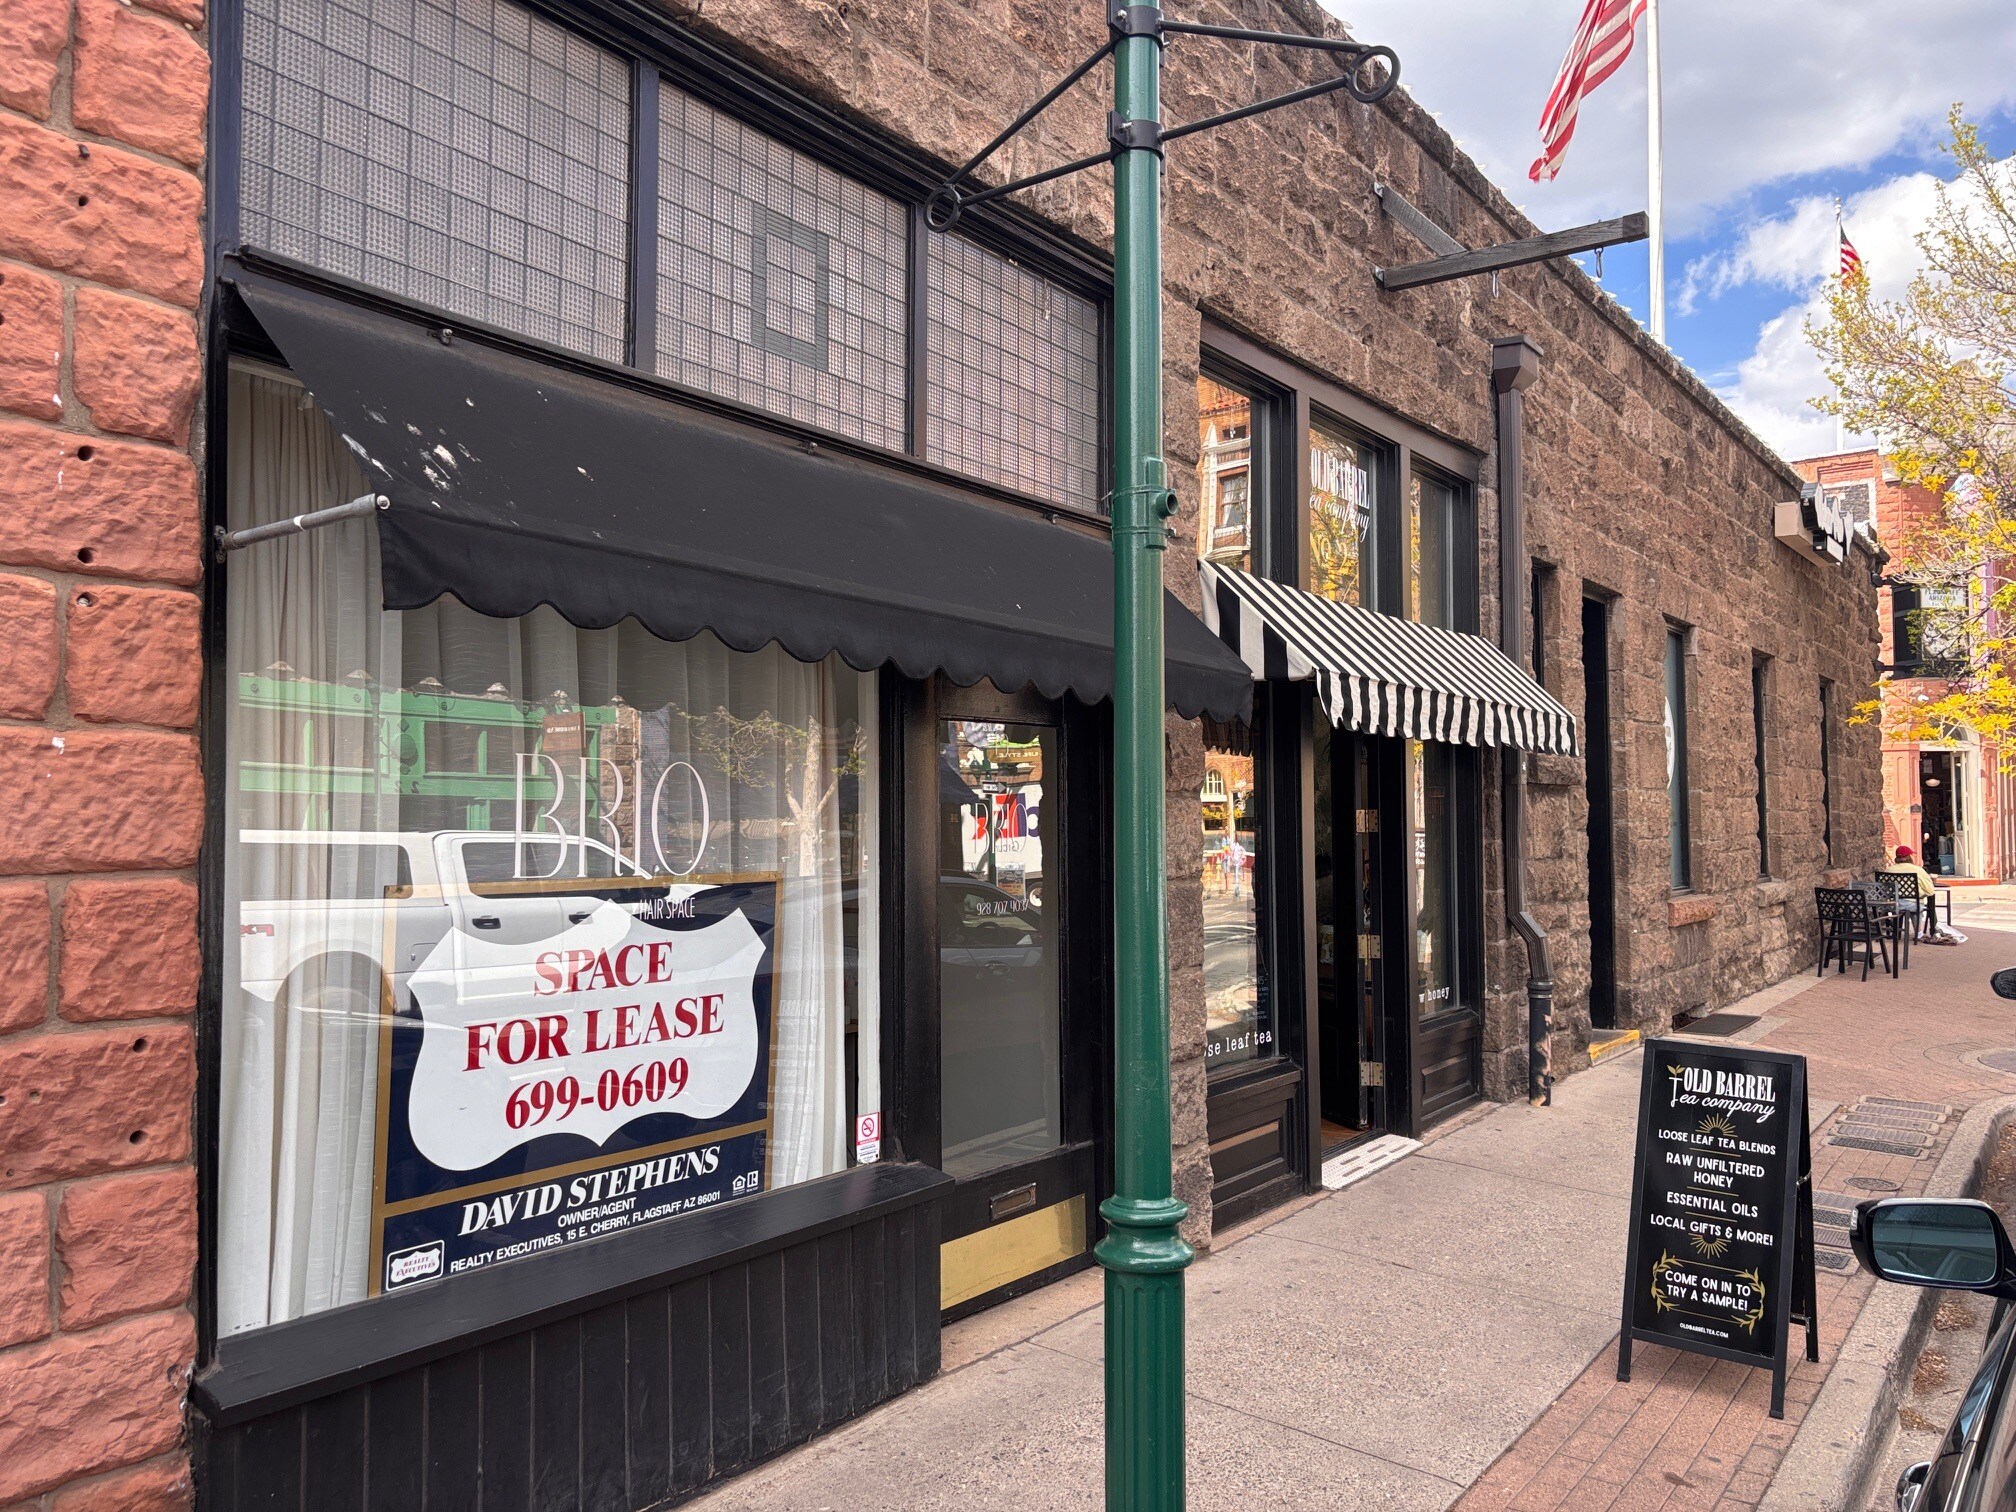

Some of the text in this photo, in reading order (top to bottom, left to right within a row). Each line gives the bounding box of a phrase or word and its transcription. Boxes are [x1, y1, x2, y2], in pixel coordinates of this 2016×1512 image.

[1310, 447, 1370, 510] OLD BARREL
[1309, 494, 1370, 543] ea company
[512, 753, 710, 880] BRIO
[975, 803, 1028, 854] BRIO
[639, 897, 696, 920] HAIR SPACE
[976, 902, 991, 916] 928
[993, 900, 1008, 914] 707
[533, 941, 673, 997] SPACE
[1427, 986, 1450, 1002] honey
[462, 1014, 571, 1072] FOR
[582, 993, 725, 1054] LEASE
[1225, 1032, 1250, 1052] leaf
[1254, 1030, 1272, 1046] tea
[505, 1057, 689, 1129] 699-0609
[1669, 1077, 1776, 1124] Tea company
[1683, 1066, 1776, 1103] OLD BARREL
[1658, 1128, 1776, 1155] LOOSE LEAF TEA BLENDS
[1666, 1152, 1765, 1178] RAW UNFILTERED
[1693, 1170, 1734, 1188] HONEY
[457, 1183, 563, 1236] DAVID
[566, 1145, 721, 1208] STEPHENS
[1666, 1191, 1758, 1218] ESSENTIAL OILS
[557, 1197, 637, 1228] OWNER/AGENT
[450, 1250, 494, 1273] REALTY
[496, 1232, 563, 1260] EXECUTIVES,
[566, 1229, 576, 1241] 15
[578, 1227, 588, 1237] E.
[590, 1216, 631, 1234] CHERRY,
[633, 1203, 682, 1223] FLAGSTAFF
[683, 1196, 696, 1209] AZ
[697, 1190, 721, 1206] 86001
[1650, 1213, 1774, 1246] LOCAL GIFTS & MORE!
[1664, 1270, 1751, 1297] COME ON IN TO
[1667, 1284, 1748, 1311] TRY A SAMPLE!
